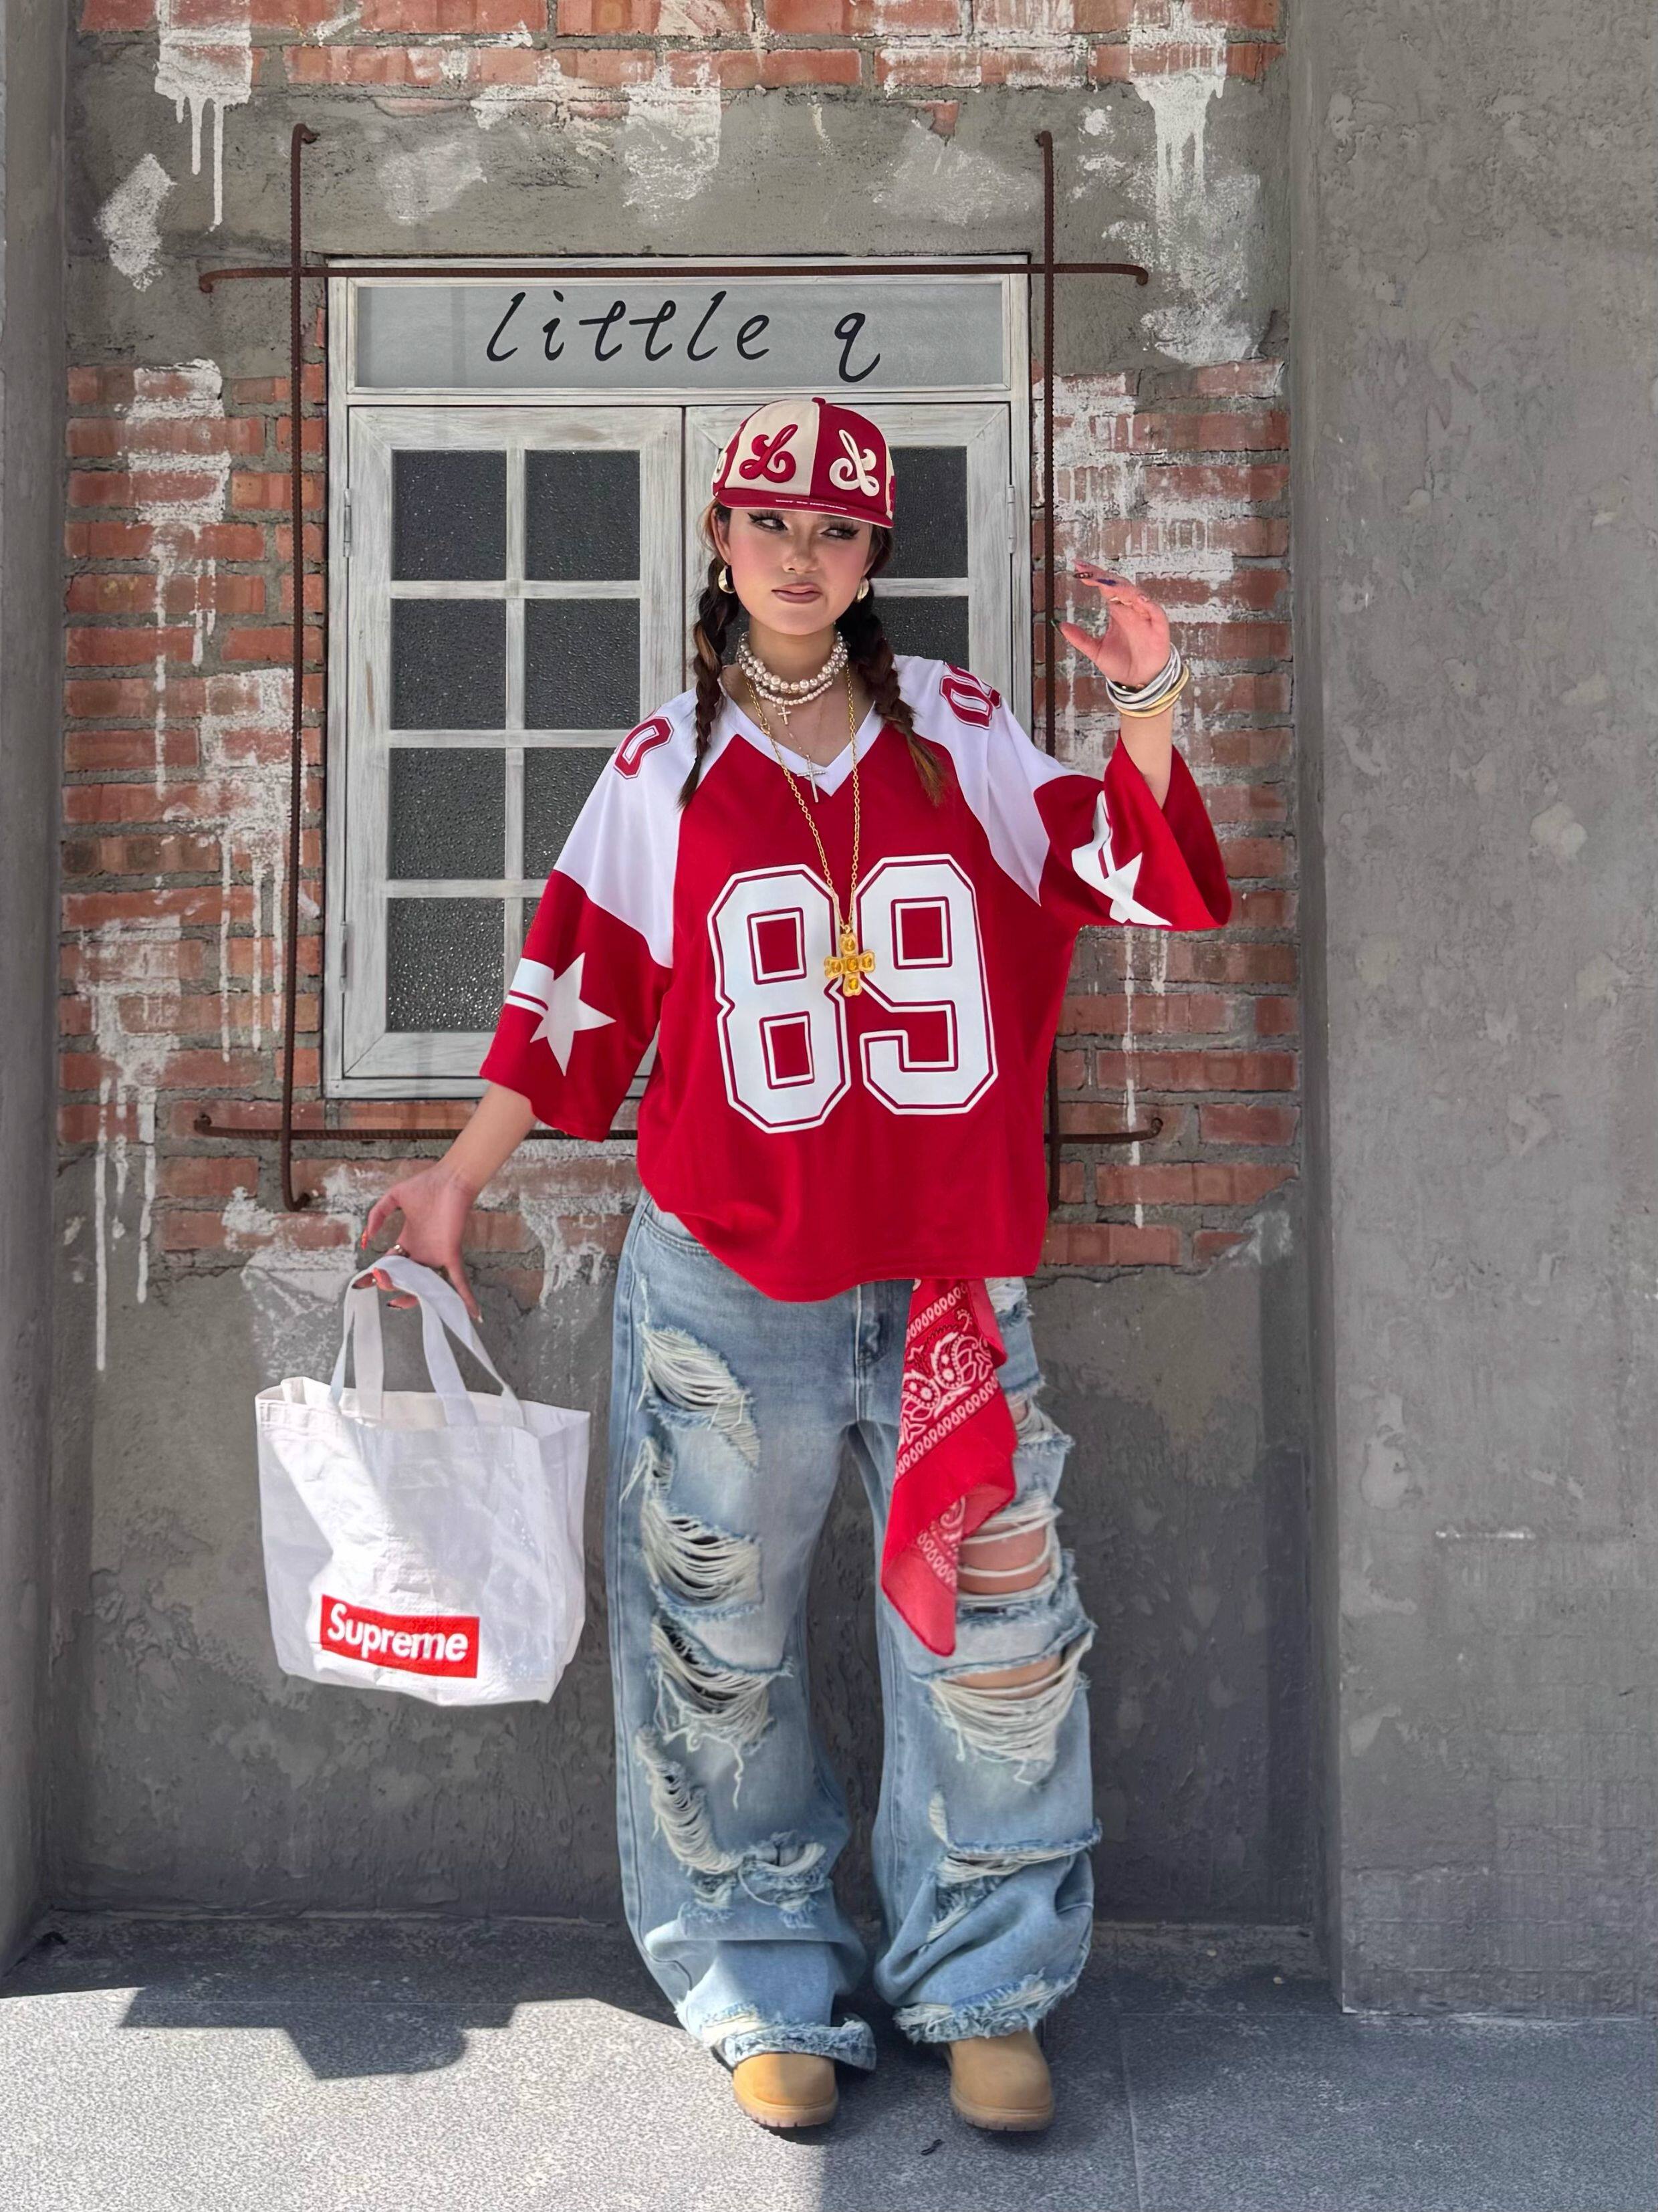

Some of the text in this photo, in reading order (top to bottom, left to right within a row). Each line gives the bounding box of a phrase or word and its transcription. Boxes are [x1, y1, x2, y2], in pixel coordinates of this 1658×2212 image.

[487, 290, 880, 382] little q
[707, 853, 999, 1134] 89
[327, 1602, 469, 1662] Supreme
